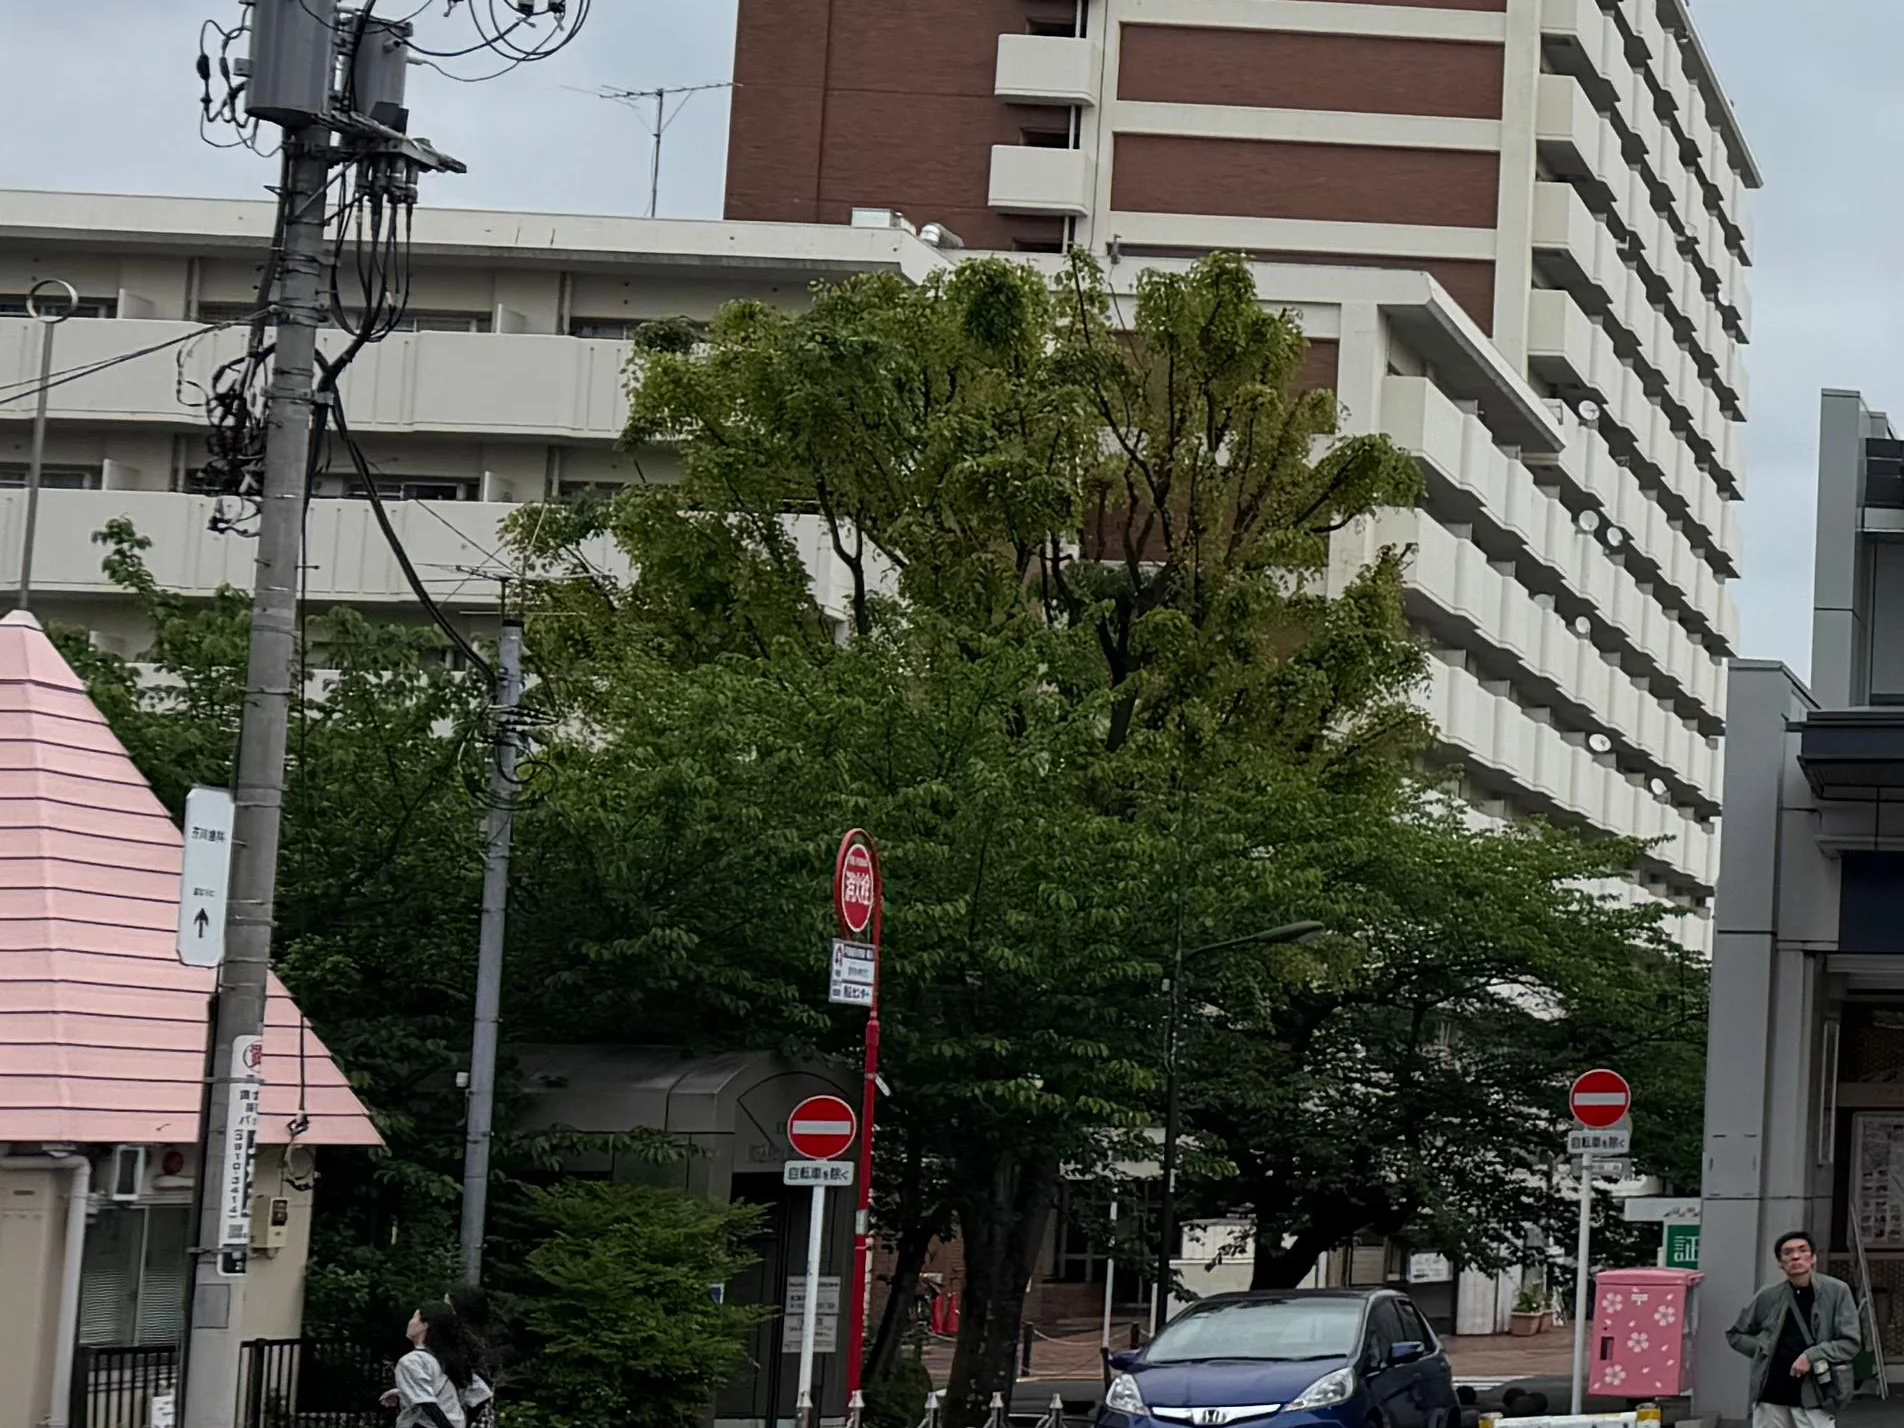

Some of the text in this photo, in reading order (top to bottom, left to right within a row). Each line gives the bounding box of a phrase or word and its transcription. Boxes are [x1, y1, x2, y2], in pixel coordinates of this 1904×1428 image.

[1571, 1135, 1625, 1149] 自転車を除く
[788, 1166, 849, 1181] 自転車を除く
